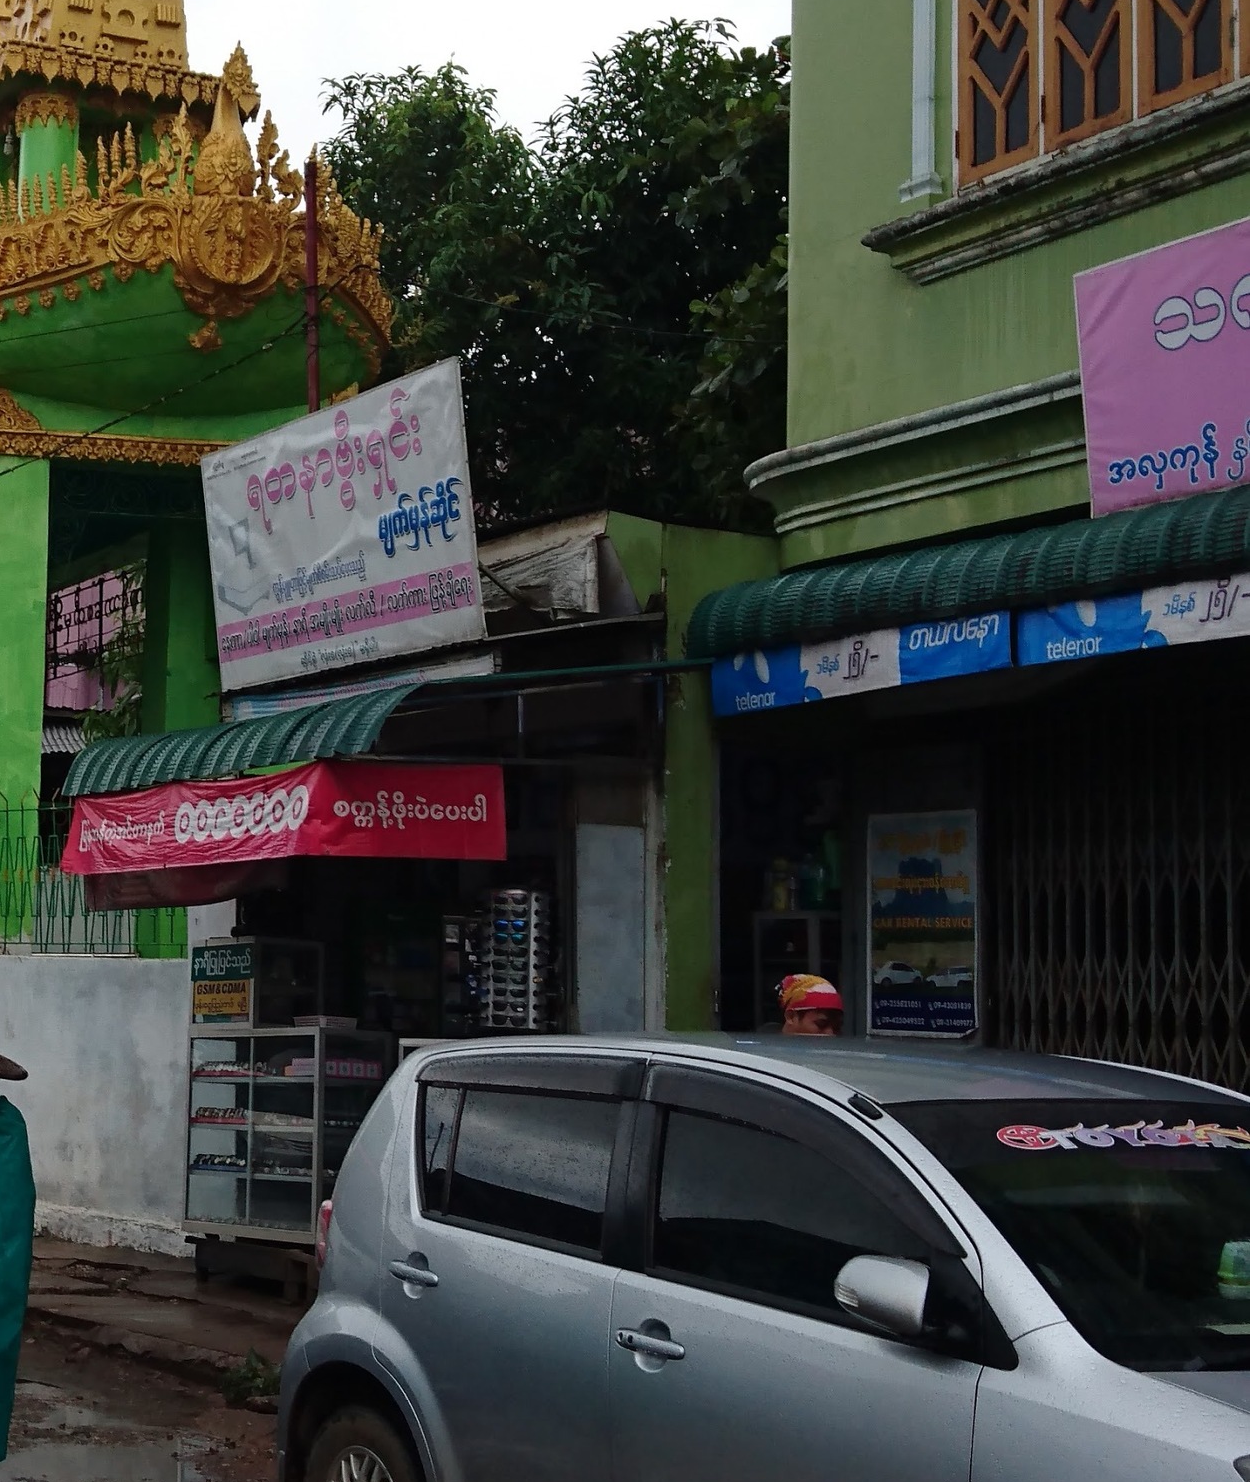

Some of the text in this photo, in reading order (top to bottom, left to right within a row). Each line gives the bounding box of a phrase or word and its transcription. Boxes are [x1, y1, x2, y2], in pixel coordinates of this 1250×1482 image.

[1047, 636, 1102, 660] telenor
[735, 691, 775, 711] telenor
[176, 789, 306, 837] ooredoo
[895, 916, 932, 929] RENTAL
[935, 917, 973, 929] SERVICE
[196, 982, 247, 995] GSM&CDMA
[1040, 1119, 1237, 1150] TOYOTA
